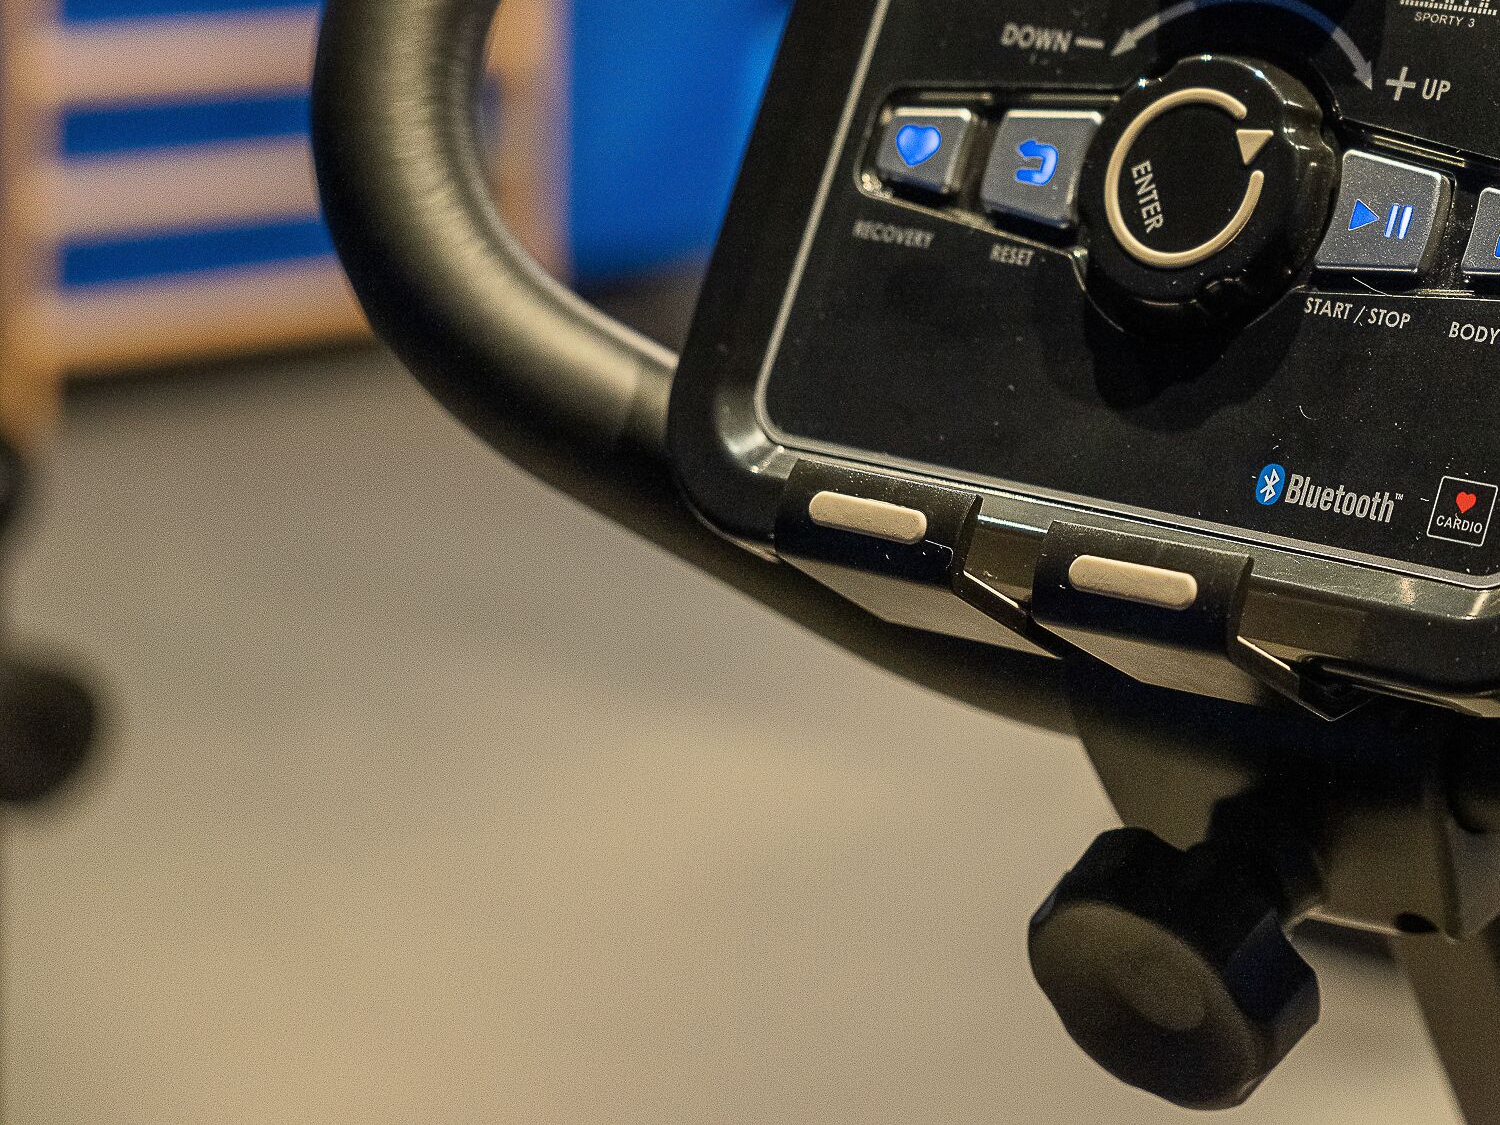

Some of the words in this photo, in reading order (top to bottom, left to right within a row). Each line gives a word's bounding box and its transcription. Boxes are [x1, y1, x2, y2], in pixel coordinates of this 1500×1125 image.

[1414, 11, 1464, 26] SPORTY
[1467, 16, 1476, 27] 3
[1001, 22, 1073, 54] DOWN
[1422, 79, 1452, 101] UP
[1131, 160, 1164, 234] ENTER
[990, 244, 1035, 267] RESET
[1304, 297, 1353, 321] START
[1368, 308, 1411, 329] STOP
[1449, 322, 1500, 345] BODY
[1436, 515, 1484, 534] CARDIO
